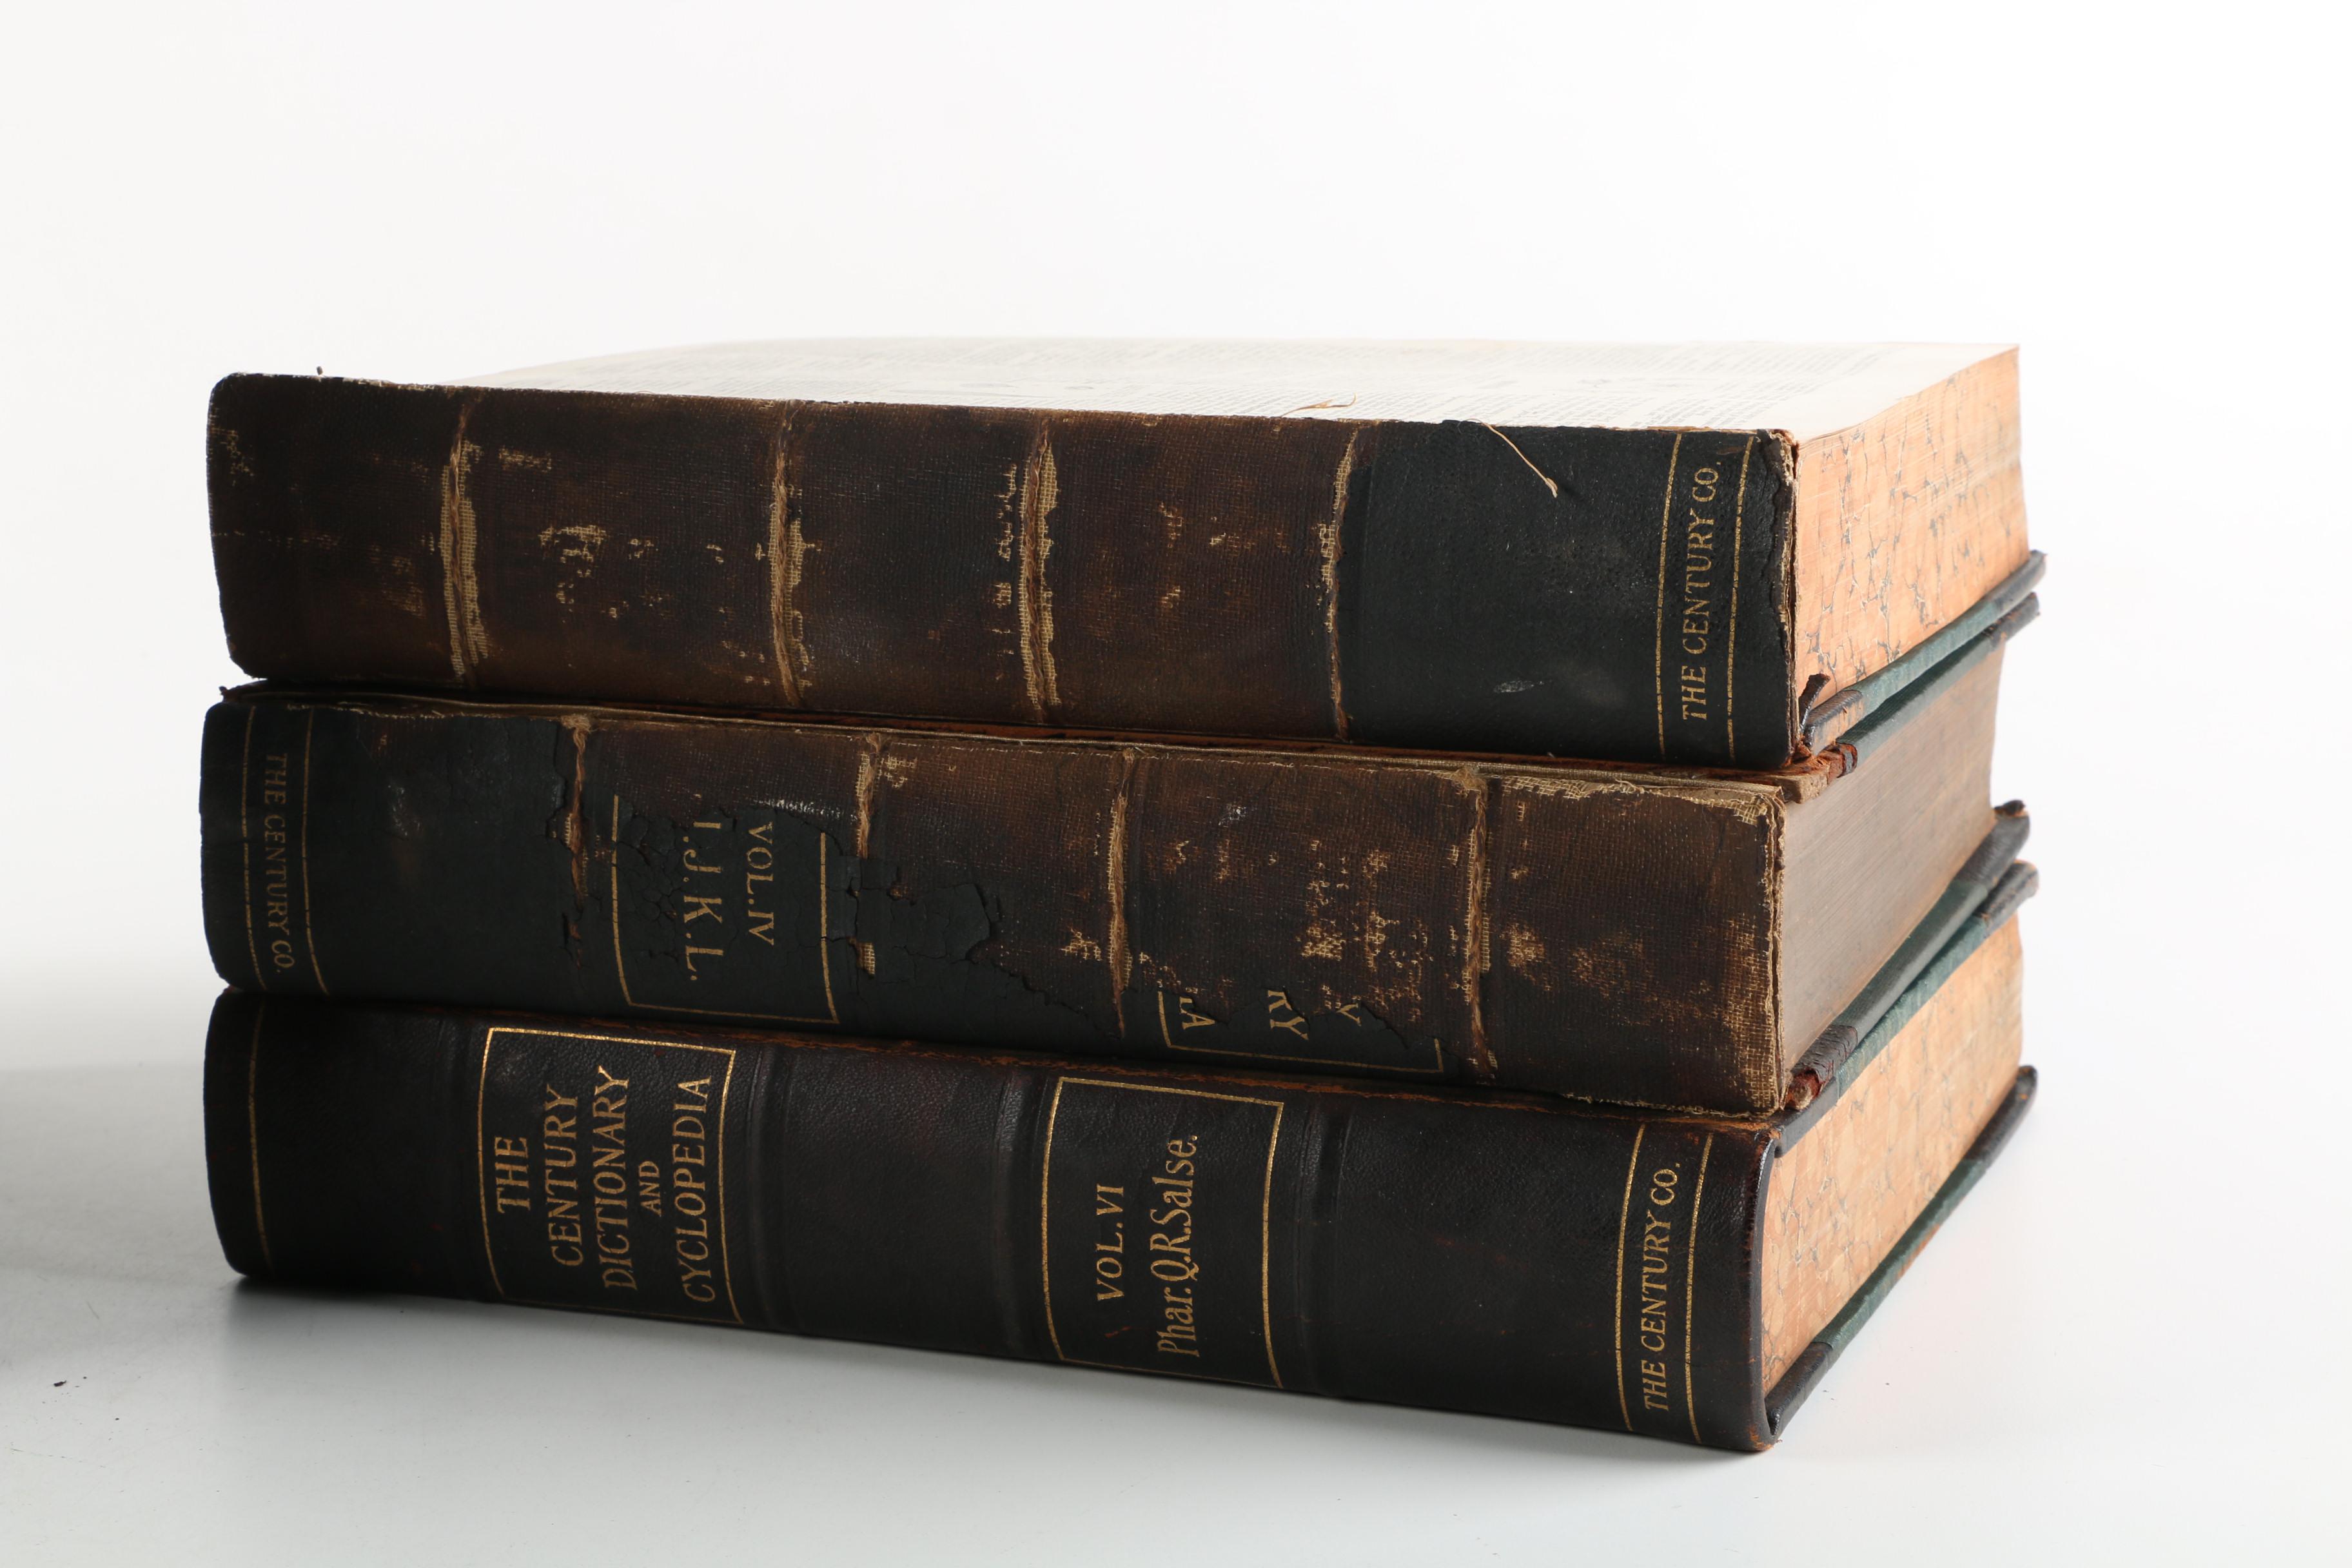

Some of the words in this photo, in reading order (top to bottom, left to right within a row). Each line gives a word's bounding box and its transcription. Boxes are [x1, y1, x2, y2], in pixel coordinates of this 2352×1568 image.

[1691, 460, 1721, 503] CO.
[1682, 507, 1715, 655] CENTURY
[1681, 665, 1708, 721] THE
[264, 752, 288, 805] THE
[264, 814, 290, 936] CENTURY
[271, 939, 295, 974] CO.
[494, 1135, 531, 1214] THE
[544, 1083, 584, 1266] CENTURY
[591, 1064, 638, 1290] DICTIONARY
[638, 1160, 663, 1217] AND
[672, 1075, 716, 1303] CYCLOPEDIA
[1649, 1161, 1681, 1206] CO.
[1640, 1208, 1672, 1353] CENTURY
[1640, 1359, 1669, 1412] THE
